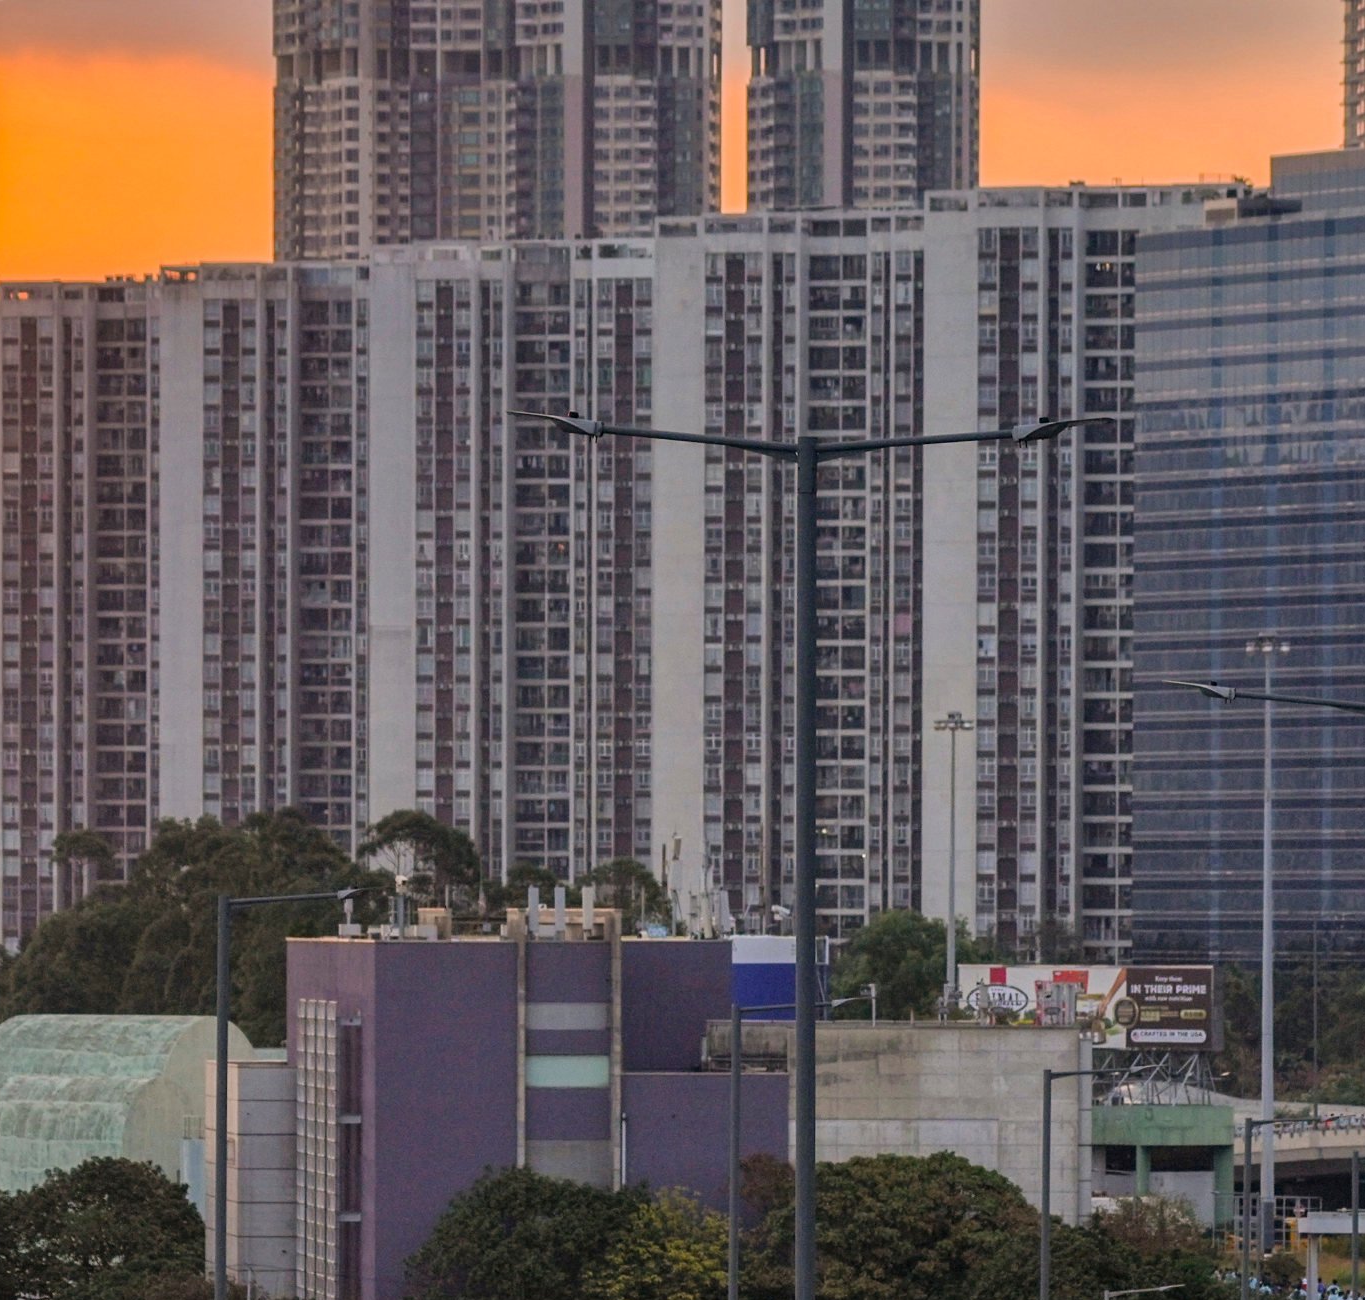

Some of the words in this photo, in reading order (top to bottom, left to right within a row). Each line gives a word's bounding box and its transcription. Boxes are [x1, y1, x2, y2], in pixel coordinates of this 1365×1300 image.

[1131, 984, 1141, 994] IN
[1144, 984, 1173, 994] THEIR
[1175, 984, 1207, 994] PRIME
